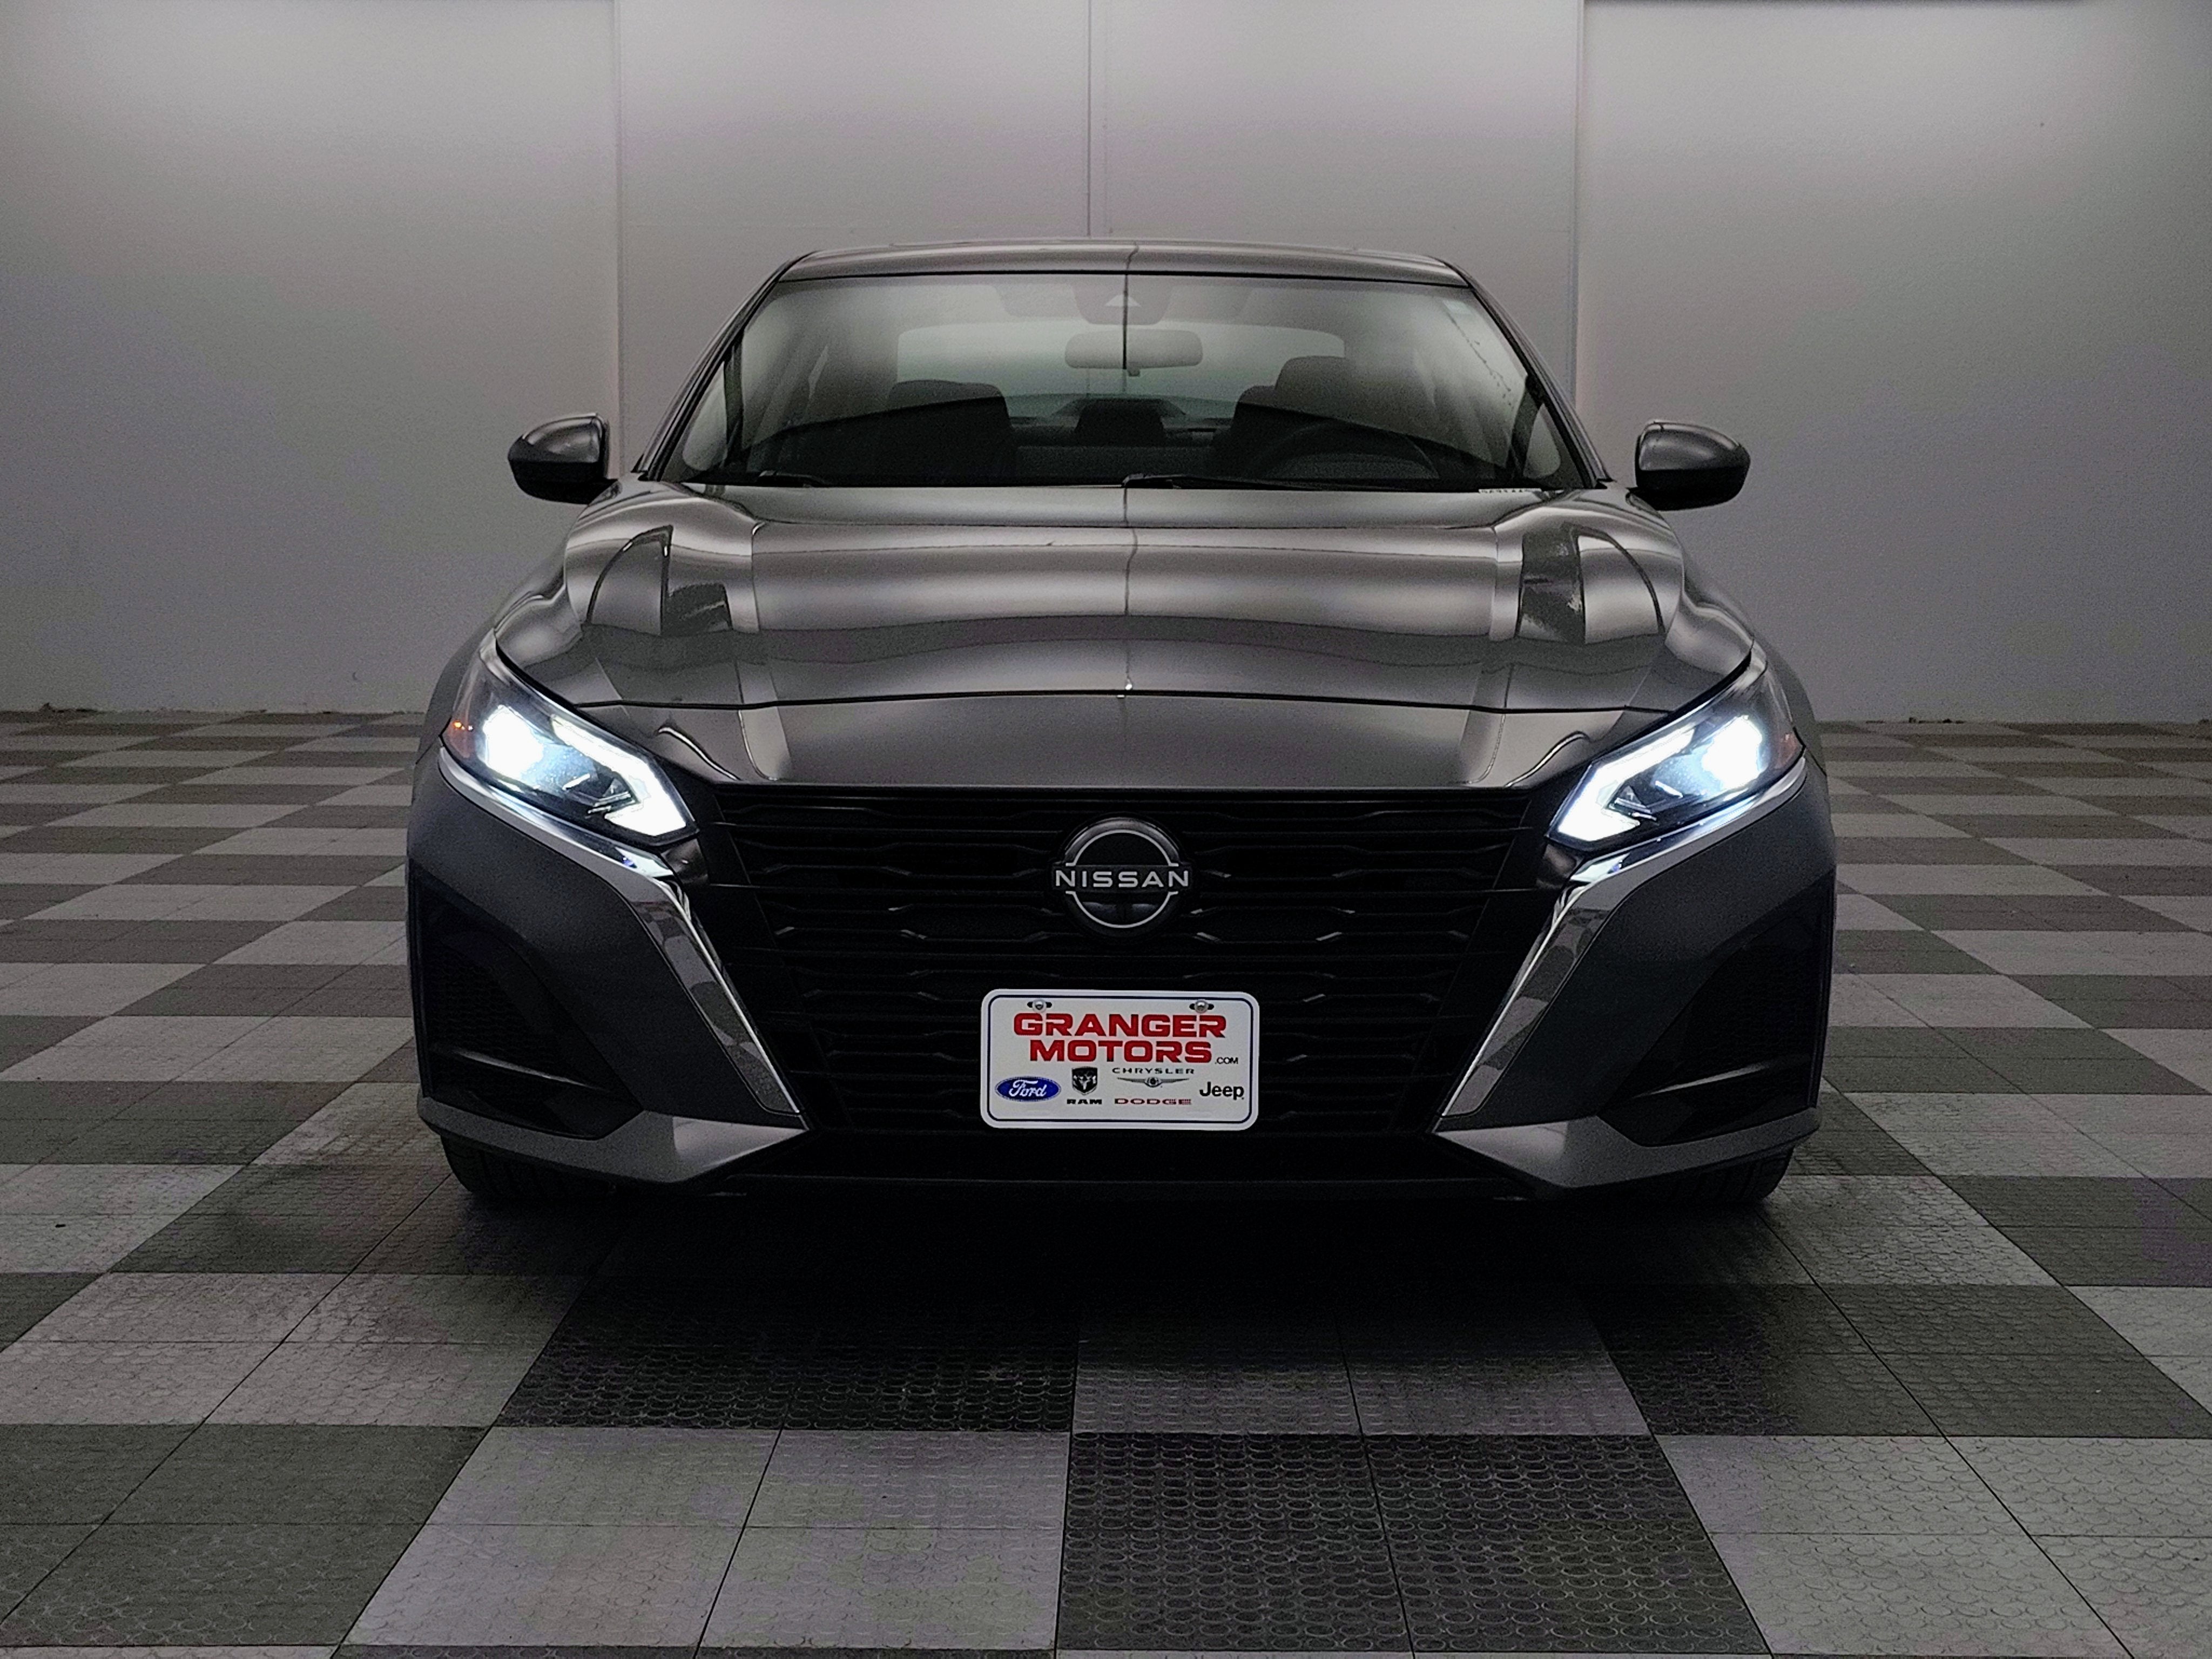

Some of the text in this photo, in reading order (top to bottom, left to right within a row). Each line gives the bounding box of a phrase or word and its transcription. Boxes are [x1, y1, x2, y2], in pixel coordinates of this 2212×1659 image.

[1056, 870, 1188, 888] NISSAN
[1014, 1013, 1227, 1038] GRANGER
[1030, 1040, 1212, 1063] MOTORS
[1008, 1080, 1047, 1097] Ford
[1199, 1081, 1244, 1100] Jeep
